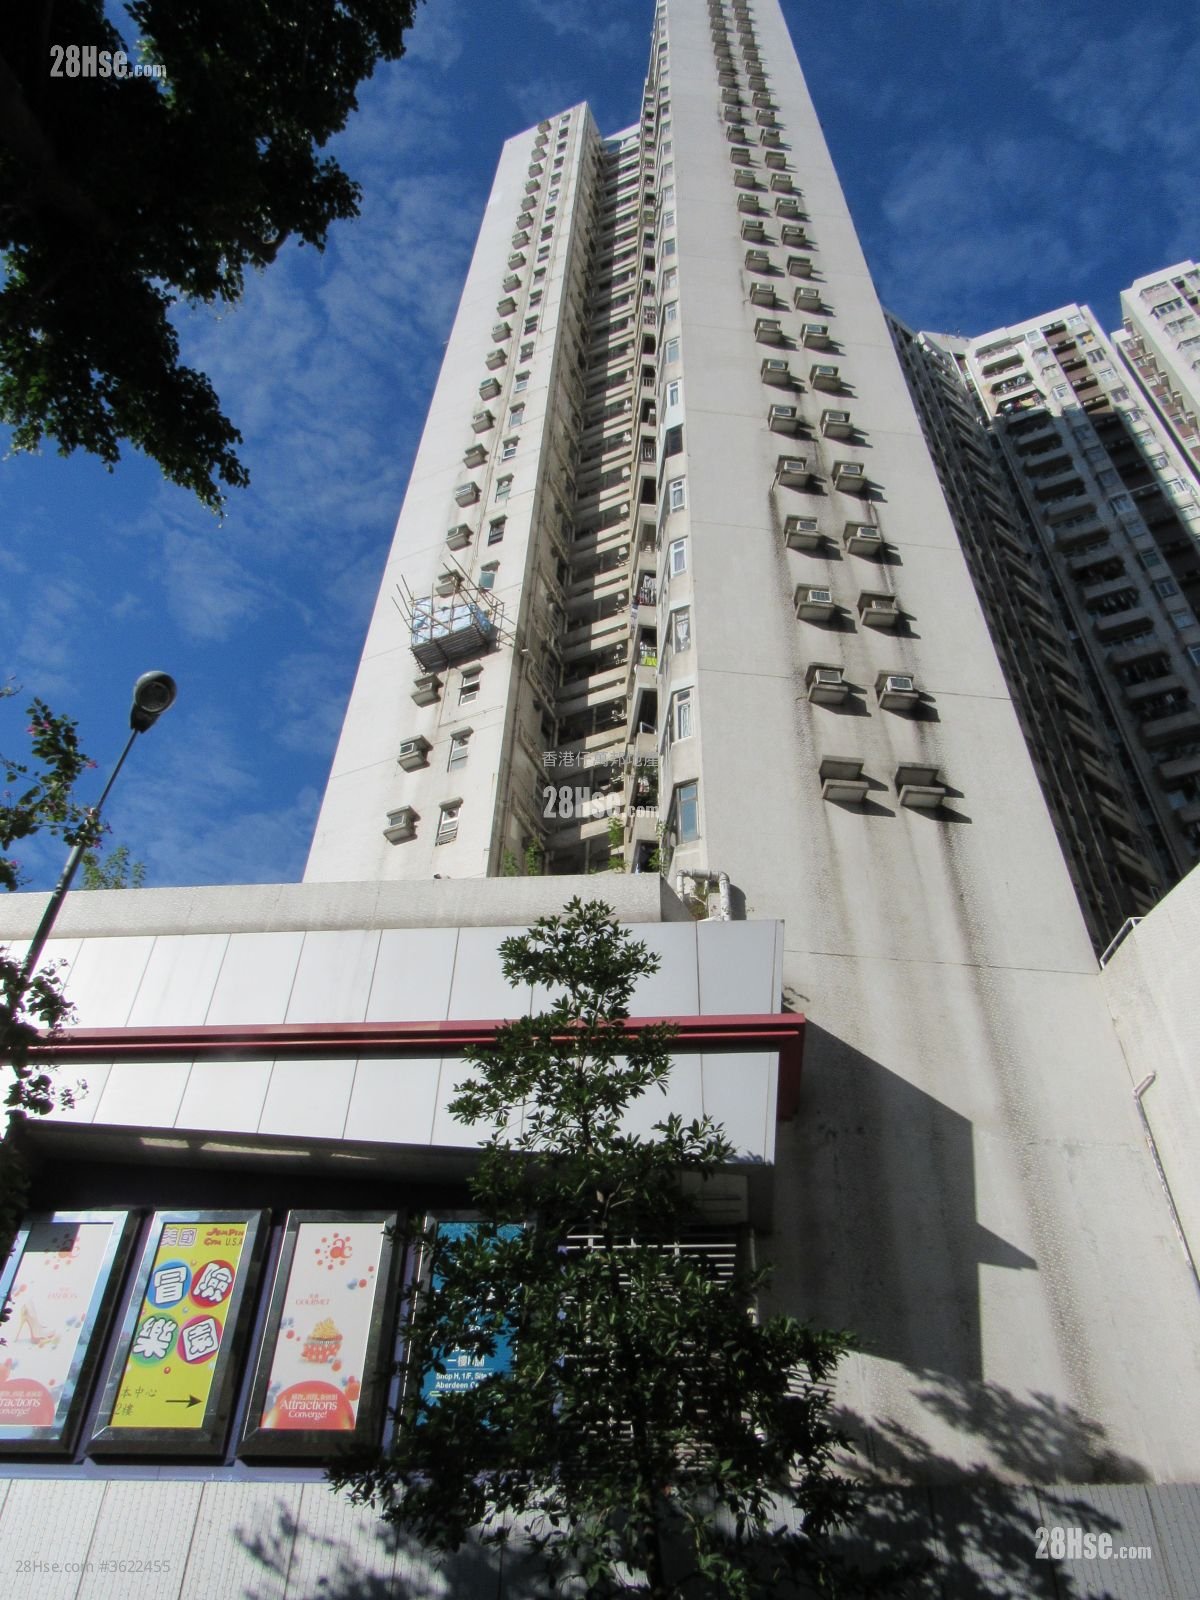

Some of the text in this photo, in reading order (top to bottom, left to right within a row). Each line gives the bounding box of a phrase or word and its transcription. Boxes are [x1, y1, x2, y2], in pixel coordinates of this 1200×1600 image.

[154, 1262, 233, 1304] 冒險
[132, 1316, 219, 1361] 樂園
[435, 1381, 468, 1389] Aberdeen
[280, 1399, 338, 1410] Attractions
[288, 1410, 328, 1420] Converge!
